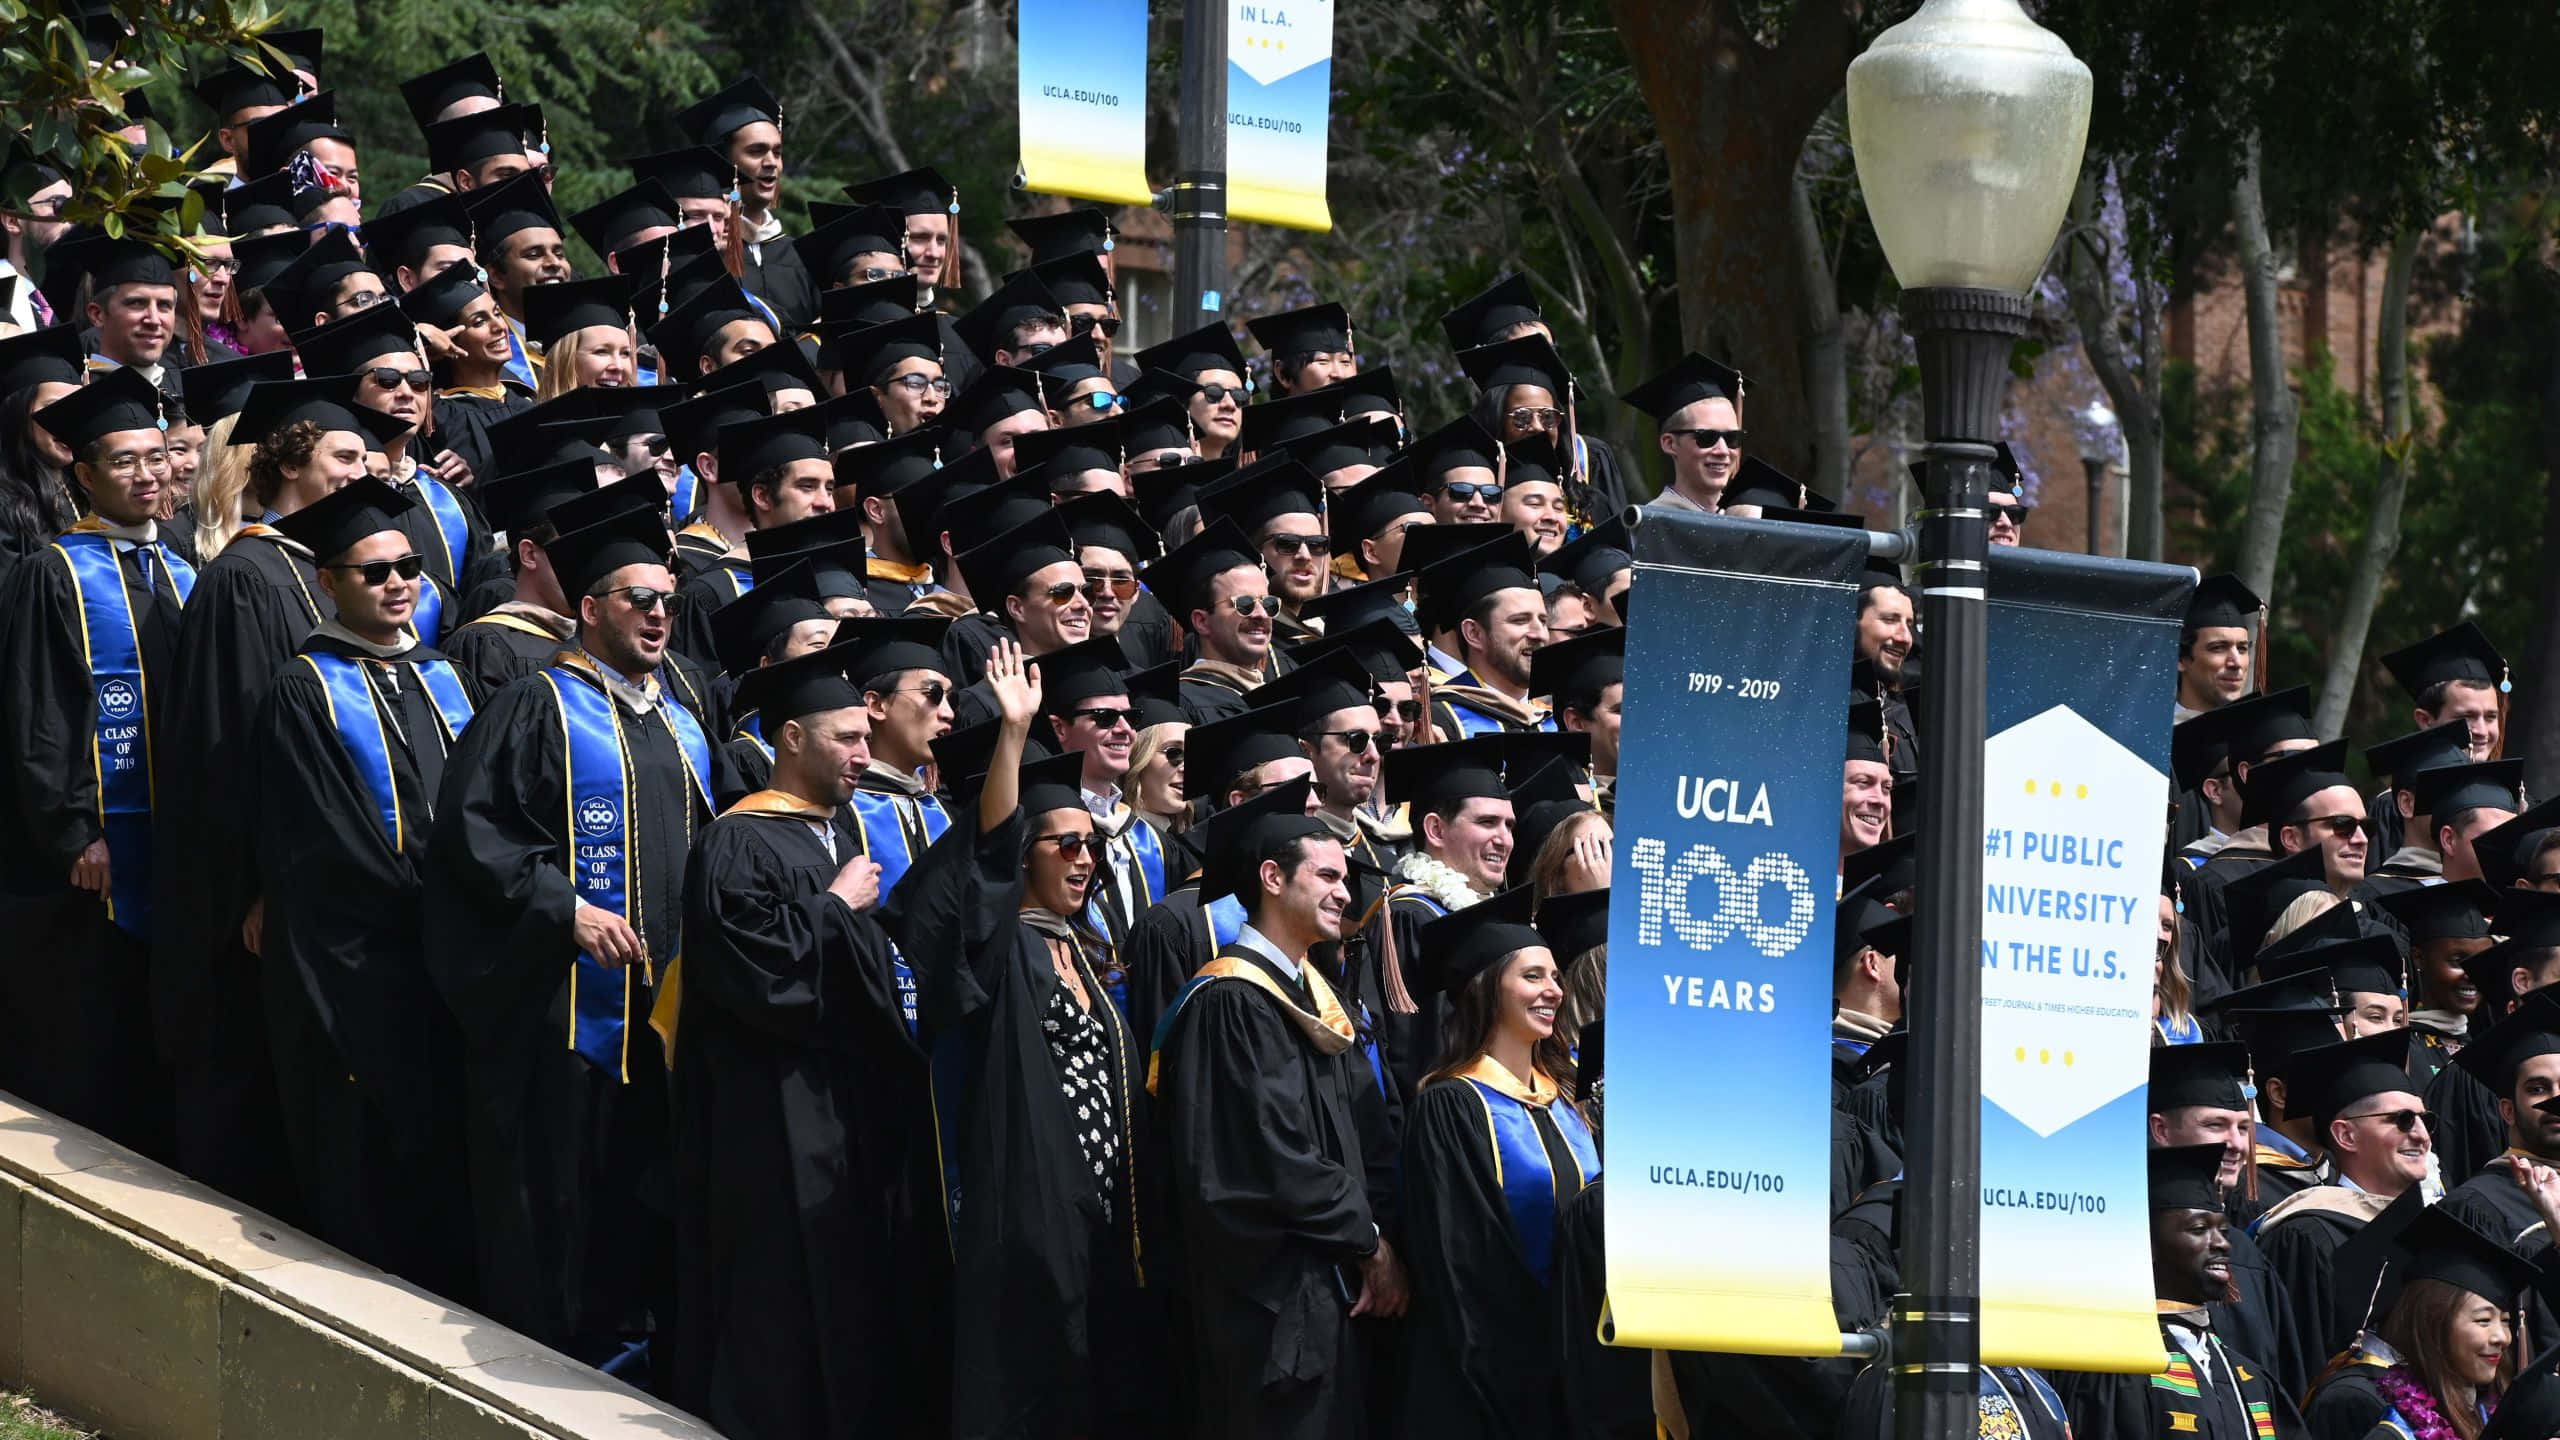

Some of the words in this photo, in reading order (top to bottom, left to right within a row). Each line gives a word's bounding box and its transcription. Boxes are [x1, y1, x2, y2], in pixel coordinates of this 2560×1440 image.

[1241, 5, 1256, 22] IN
[1262, 8, 1292, 28] L.A.
[1043, 84, 1119, 107] UCLA.EDU/100
[1228, 112, 1302, 134] UCLA.EDU/100
[1688, 672, 1723, 694] 1919
[1738, 678, 1781, 700] 2019
[103, 693, 133, 706] 100
[105, 726, 138, 740] CLASS
[116, 743, 131, 754] OF
[114, 758, 135, 770] 2019
[1676, 775, 1774, 827] UCLA
[583, 809, 614, 823] 100
[581, 845, 617, 858] CLASS
[1986, 828, 2012, 858] #1
[2023, 832, 2123, 869] PUBLIC
[591, 862, 607, 874] OF
[588, 878, 611, 890] 2019
[1631, 837, 1815, 957] 100
[1987, 884, 2138, 925] NIVERSITY
[1981, 939, 1998, 969] N
[2008, 942, 2062, 975] THE
[2073, 948, 2126, 980] U.S.
[1663, 974, 1775, 1013] YEARS
[2097, 1007, 2140, 1019] EDUCATION
[1650, 1165, 1784, 1194] UCLA.EDU/100
[1984, 1188, 2106, 1214] UCLA.EDU/100
